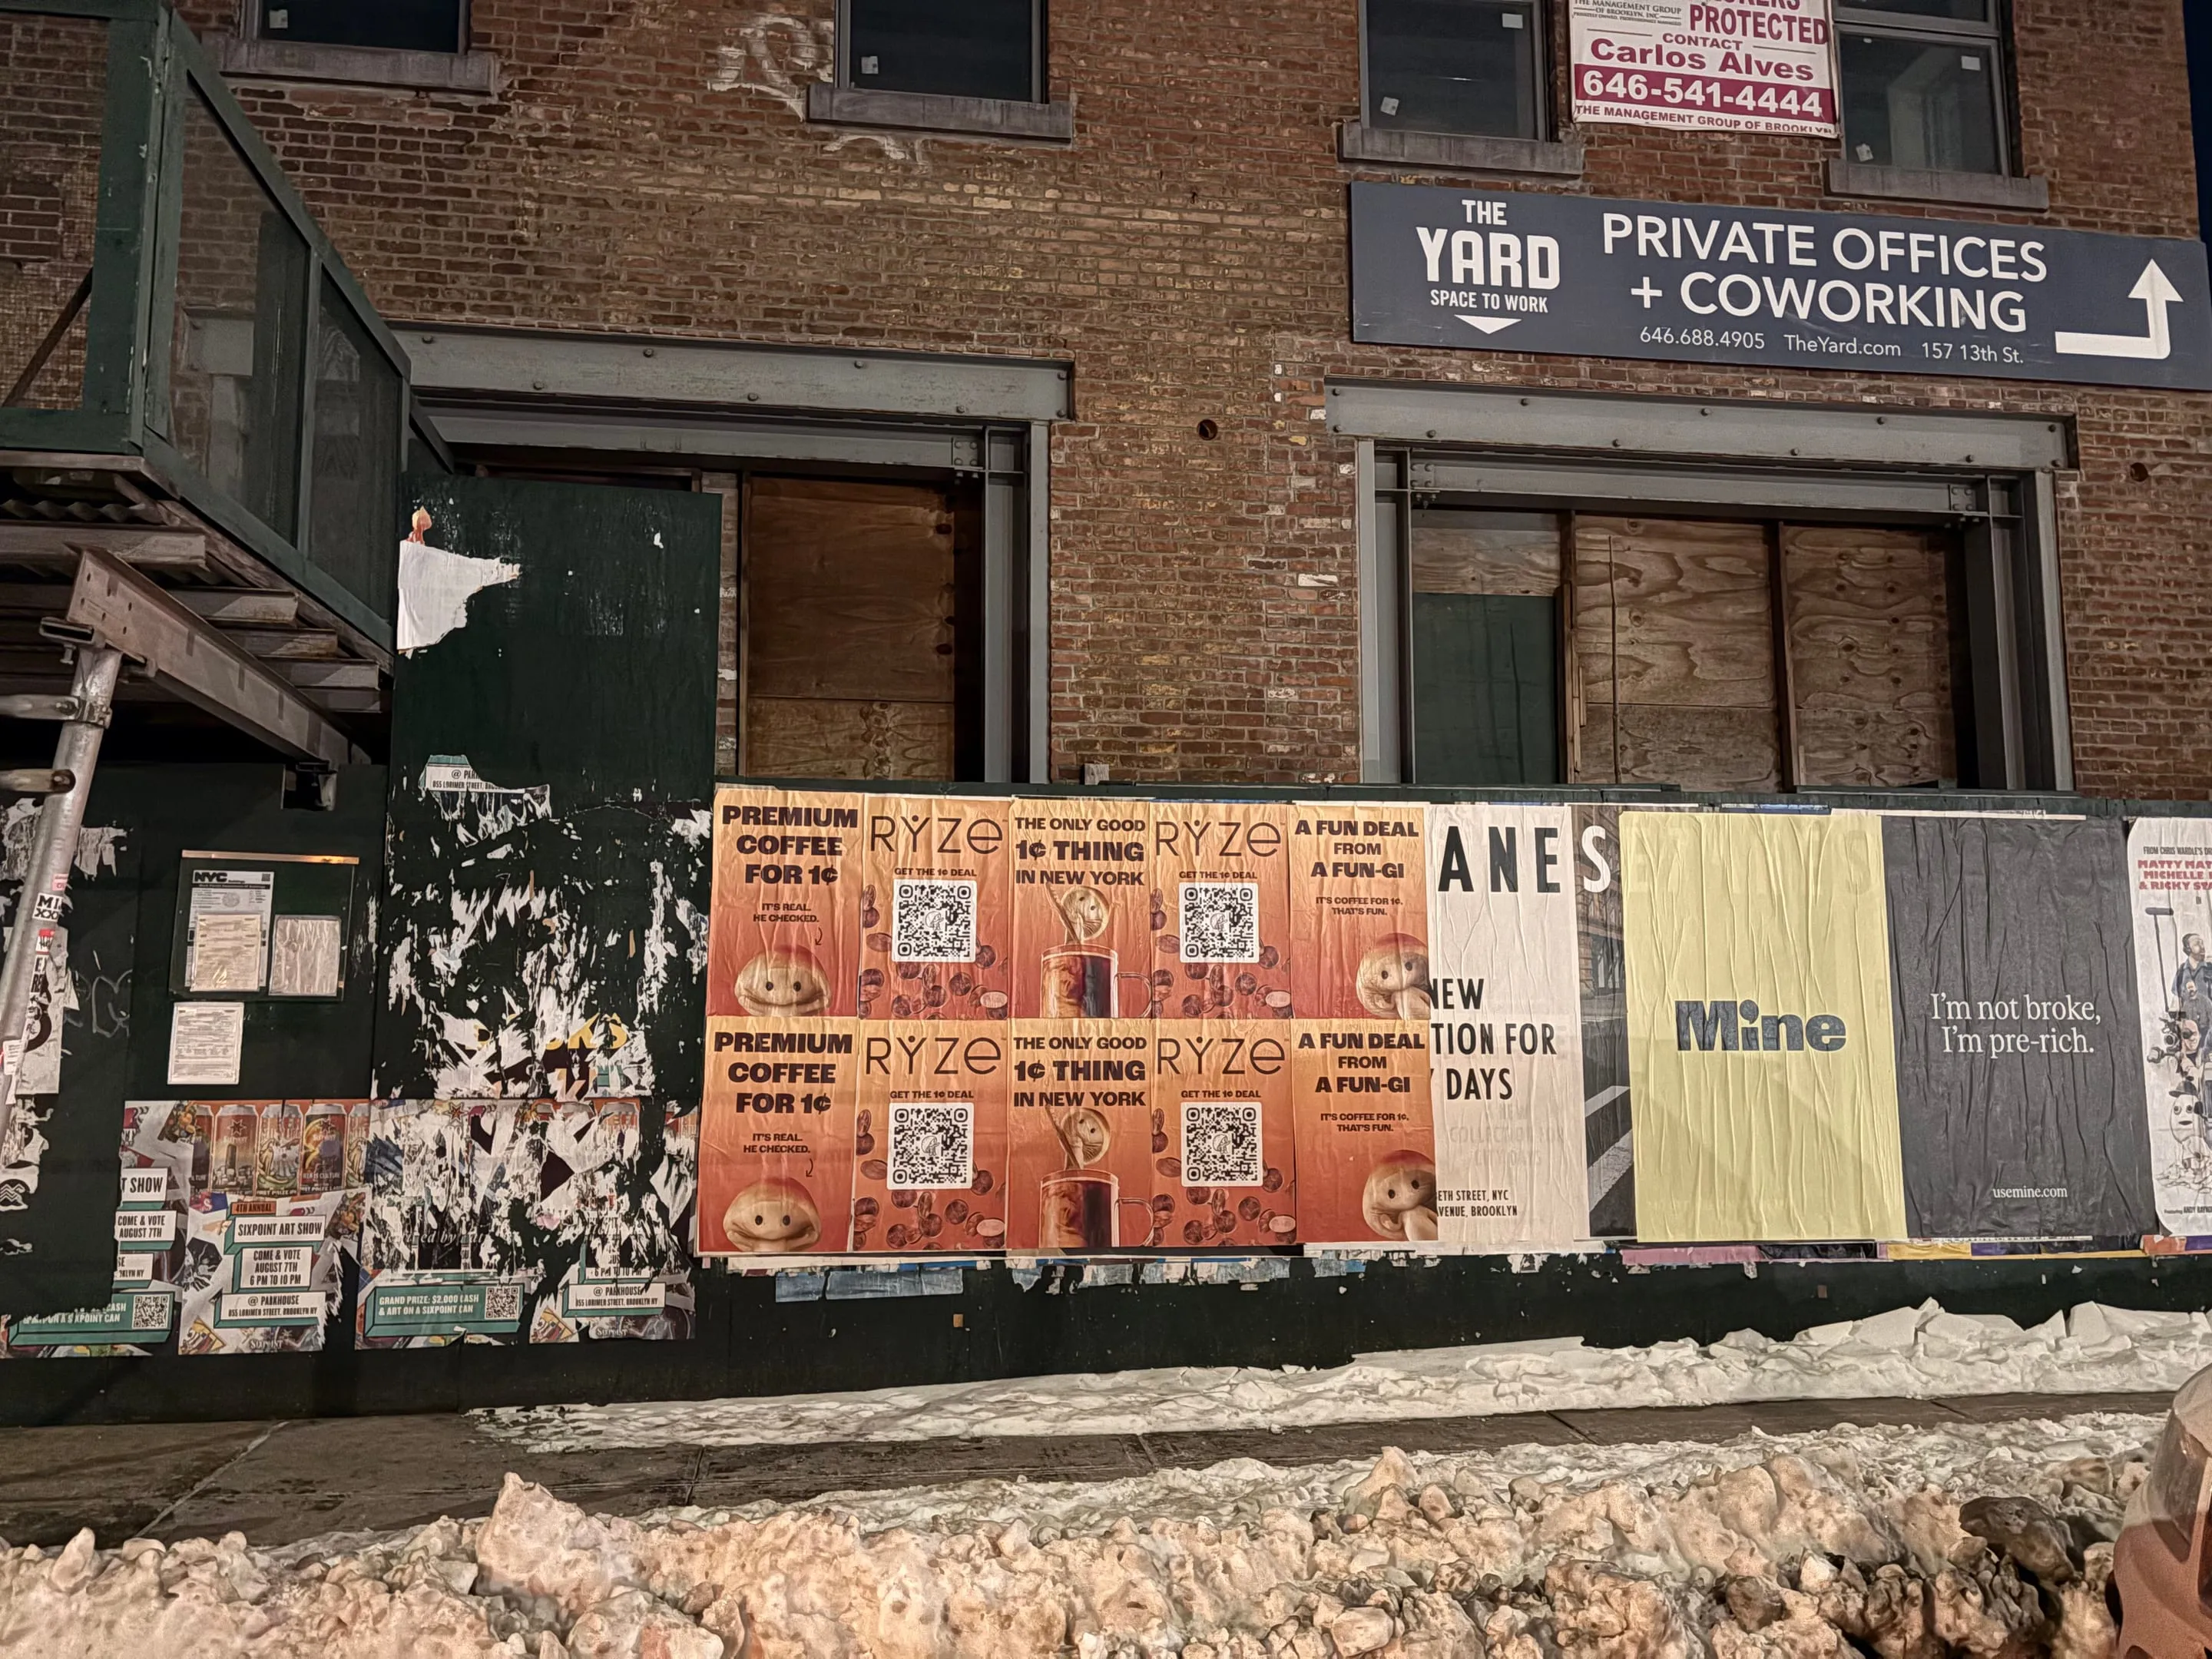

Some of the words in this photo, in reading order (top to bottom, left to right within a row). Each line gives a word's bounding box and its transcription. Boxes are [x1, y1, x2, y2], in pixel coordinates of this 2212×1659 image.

[1653, 5, 1681, 15] GROUP
[1690, 4, 1828, 45] PROTECTED
[1662, 32, 1743, 51] CONTACT
[1590, 38, 1707, 70] Carlos
[1719, 51, 1813, 81] Alves
[1583, 70, 1822, 118] 646-541-4444
[1576, 104, 1601, 115] THE
[1604, 106, 1694, 124] MANAGEMENT
[1697, 116, 1741, 129] GROUP
[1745, 121, 1760, 129] OF
[1462, 199, 1508, 226] THE
[1603, 213, 1816, 267] PRIVATE
[1833, 227, 2046, 283] OFFICES
[1416, 227, 1561, 290] YARD
[1430, 289, 1477, 308] SPACE
[1482, 293, 1499, 310] TO
[1505, 294, 1548, 313] WORK
[1631, 276, 1663, 310] +
[1680, 271, 2027, 333] COWORKING
[1640, 326, 1764, 350] 646.688.4905
[1783, 334, 1901, 358] TheYard.com
[1922, 343, 1952, 359] 157
[1961, 344, 1997, 363] 13th
[2002, 346, 2024, 364] St.
[723, 805, 858, 828] PREMIUM
[1015, 817, 1046, 830] THE
[1050, 818, 1092, 830] ONLY
[1097, 820, 1145, 831] GOOD
[1295, 820, 1311, 835] A
[1316, 820, 1359, 836] FUN
[1363, 821, 1419, 837] DEAL
[736, 834, 843, 856] COFFEE
[1016, 839, 1046, 860] 1¢
[1053, 841, 1144, 861] THING
[1334, 843, 1381, 855] FROM
[895, 867, 912, 876] GET
[915, 867, 934, 876] THE
[951, 867, 976, 876] DEAL
[1311, 863, 1328, 877] A
[1333, 863, 1404, 879] FUN-GI
[2138, 860, 2182, 869] MATTY
[195, 872, 227, 882] NYC
[745, 864, 802, 885] FOR
[808, 864, 839, 886] 1¢
[1016, 870, 1035, 883] IN
[1040, 870, 1085, 884] NEW
[1090, 871, 1144, 886] YORK
[1179, 871, 1197, 879] GET
[1199, 871, 1217, 879] THE
[1233, 871, 1258, 879] DEAL
[2144, 871, 2204, 879] MICHELLE
[1336, 897, 1369, 906] COFFEE
[1371, 897, 1388, 906] FOR
[753, 914, 766, 922] HE
[767, 913, 820, 922] CHECKED.
[1332, 907, 1362, 916] THAT'S
[1366, 907, 1388, 916] FUN.
[1429, 979, 1484, 1009] NEW
[1931, 992, 1972, 1019] I'm
[1978, 998, 2019, 1020] not
[2024, 994, 2101, 1025] broke,
[1675, 999, 1846, 1051] Mine
[714, 1032, 853, 1054] PREMIUM
[1014, 1037, 1045, 1049] THE
[1049, 1037, 1092, 1049] ONLY
[1097, 1037, 1147, 1049] GOOD
[1298, 1033, 1316, 1048] A
[1320, 1033, 1363, 1049] FUN
[1368, 1033, 1425, 1049] DEAL
[1505, 1023, 1557, 1055] FOR
[1942, 1025, 1983, 1052] I'm
[1990, 1027, 2094, 1058] pre-rich.
[1338, 1056, 1387, 1069] FROM
[728, 1062, 836, 1084] COFFEE
[1015, 1060, 1045, 1081] 1¢
[1053, 1060, 1145, 1081] THING
[1315, 1078, 1332, 1092] A
[1337, 1077, 1410, 1092] FUN-GI
[1446, 1068, 1512, 1100] DAYS
[890, 1091, 909, 1099] GET
[911, 1091, 931, 1099] THE
[947, 1091, 974, 1099] DEAL
[1014, 1092, 1034, 1106] IN
[1039, 1092, 1084, 1106] NEW
[1090, 1091, 1146, 1106] YORK
[1181, 1090, 1199, 1099] GET
[1201, 1090, 1220, 1099] THE
[1235, 1090, 1261, 1099] DEAL
[737, 1092, 794, 1113] FOR
[801, 1092, 831, 1114] 1¢
[1320, 1113, 1339, 1121] IT'S
[1340, 1113, 1375, 1121] COFFEE
[1376, 1113, 1395, 1121] FOR
[1337, 1124, 1368, 1132] THAT'S
[752, 1134, 771, 1142] IT'S
[773, 1134, 803, 1142] REAL.
[743, 1144, 757, 1153] HE
[759, 1144, 810, 1154] CHECKED.
[131, 1177, 163, 1193] SHOW
[1992, 1185, 2068, 1199] usemine.com
[1437, 1190, 1453, 1200] ETH
[1456, 1190, 1489, 1202] STREET,
[1492, 1190, 1508, 1200] NYC
[1472, 1206, 1517, 1216] BROOKLYN
[118, 1216, 137, 1226] COME
[140, 1215, 145, 1225] &
[148, 1214, 165, 1226] VOTE
[119, 1227, 146, 1238] AUGUST
[149, 1227, 162, 1237] 7TH
[238, 1224, 276, 1236] SIXPOINT
[280, 1224, 295, 1235] ART
[297, 1223, 322, 1234] SHOW
[253, 1250, 273, 1260] COME
[276, 1250, 280, 1260] &
[283, 1250, 300, 1260] VOTE
[255, 1263, 282, 1273] AUGUST
[284, 1263, 297, 1272] 7TH
[250, 1276, 254, 1286] 6
[257, 1275, 267, 1285] PM
[270, 1275, 278, 1285] TO
[290, 1274, 301, 1284] PM
[260, 1296, 299, 1306] PARKHOUSE
[407, 1296, 430, 1305] PRIZE:
[422, 1306, 456, 1314] SIXPOINT
